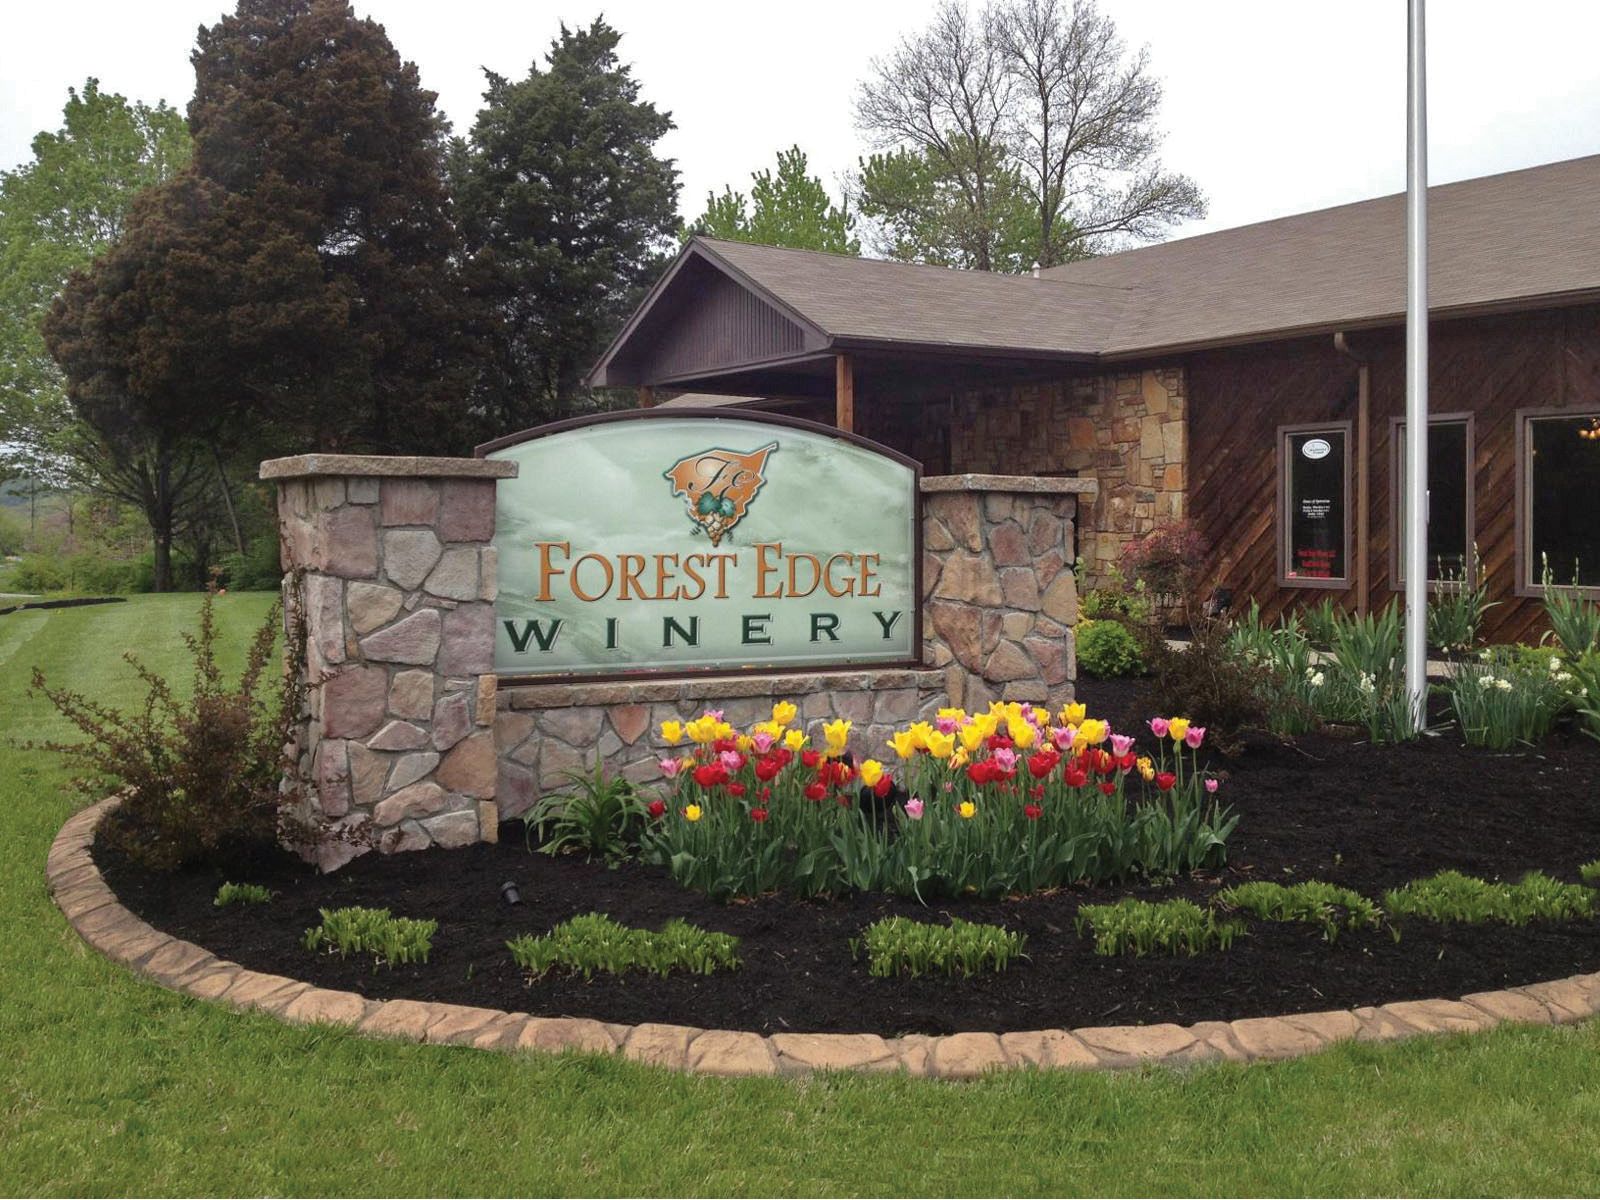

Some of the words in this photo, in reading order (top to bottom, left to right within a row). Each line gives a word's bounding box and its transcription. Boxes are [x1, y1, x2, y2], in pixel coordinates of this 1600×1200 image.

[535, 541, 737, 601] FOREST
[752, 542, 881, 599] EDGE
[503, 611, 902, 653] WINERY
